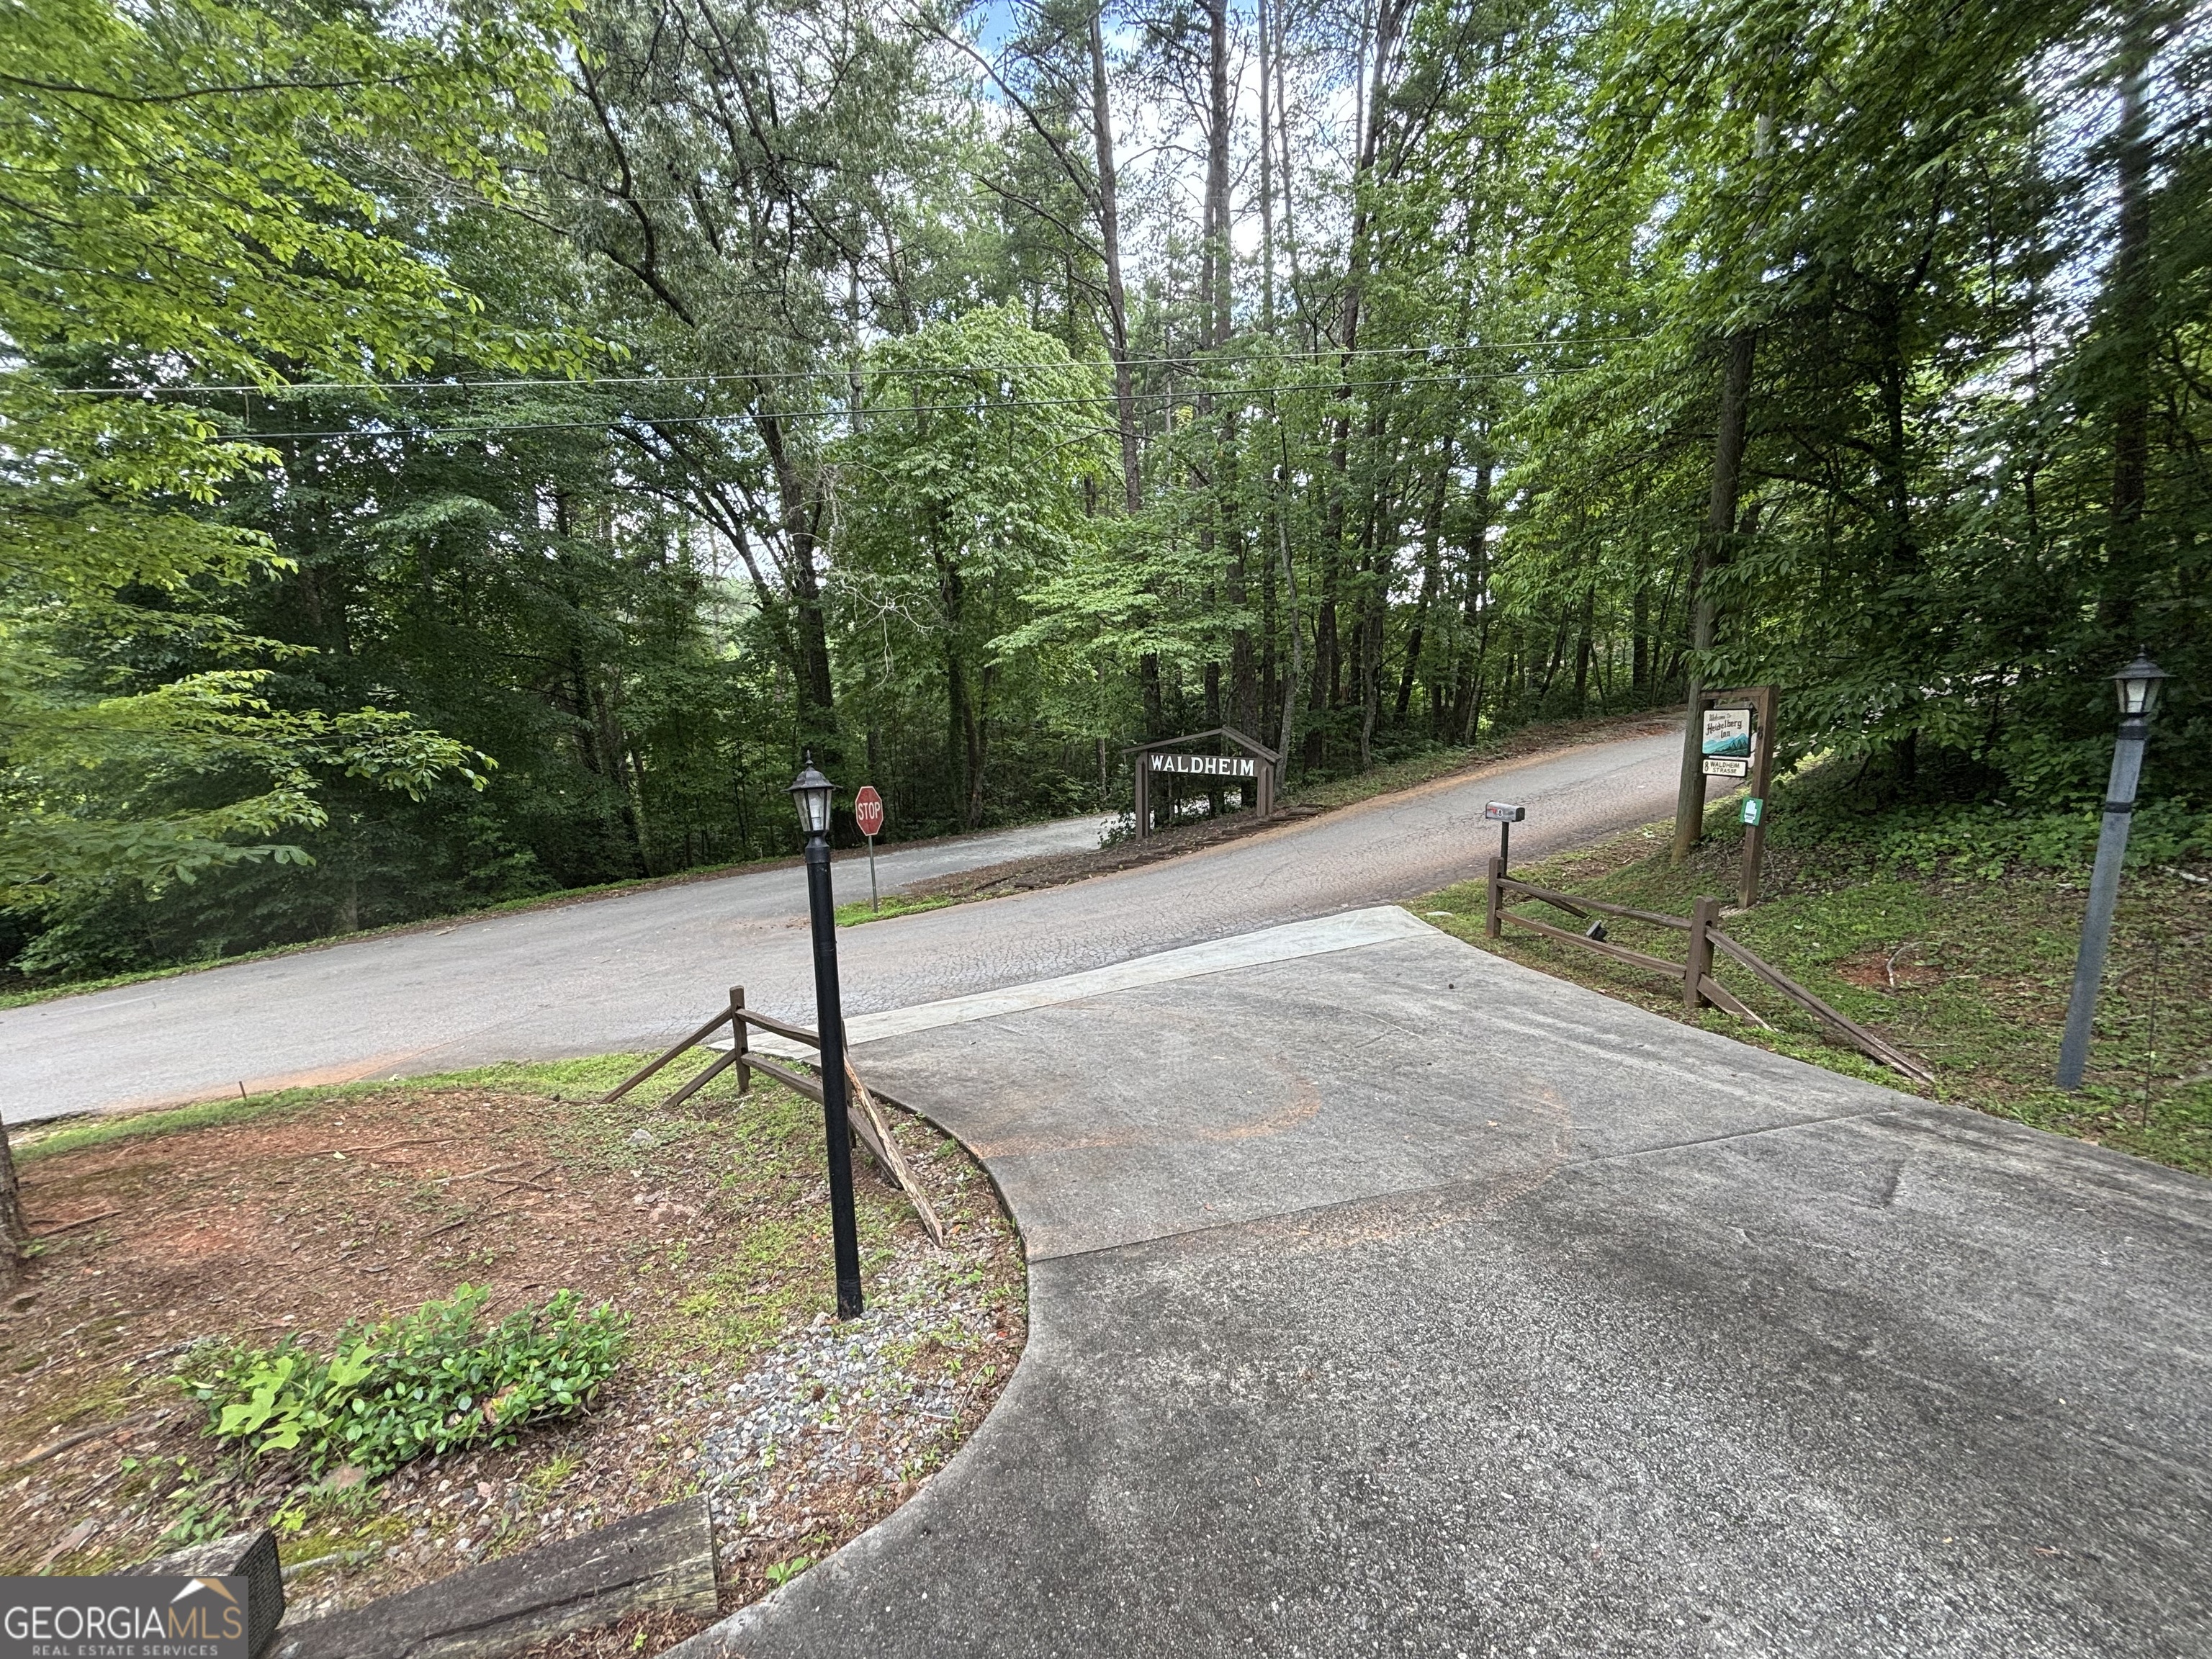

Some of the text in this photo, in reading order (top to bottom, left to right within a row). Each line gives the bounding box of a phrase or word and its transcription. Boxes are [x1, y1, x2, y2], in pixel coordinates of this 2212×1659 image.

[1706, 720, 1742, 736] Heidelberg
[1721, 730, 1731, 739] Inn
[1151, 755, 1254, 777] WALDHEIM
[1704, 761, 1709, 772] 8
[858, 801, 881, 821] STOP
